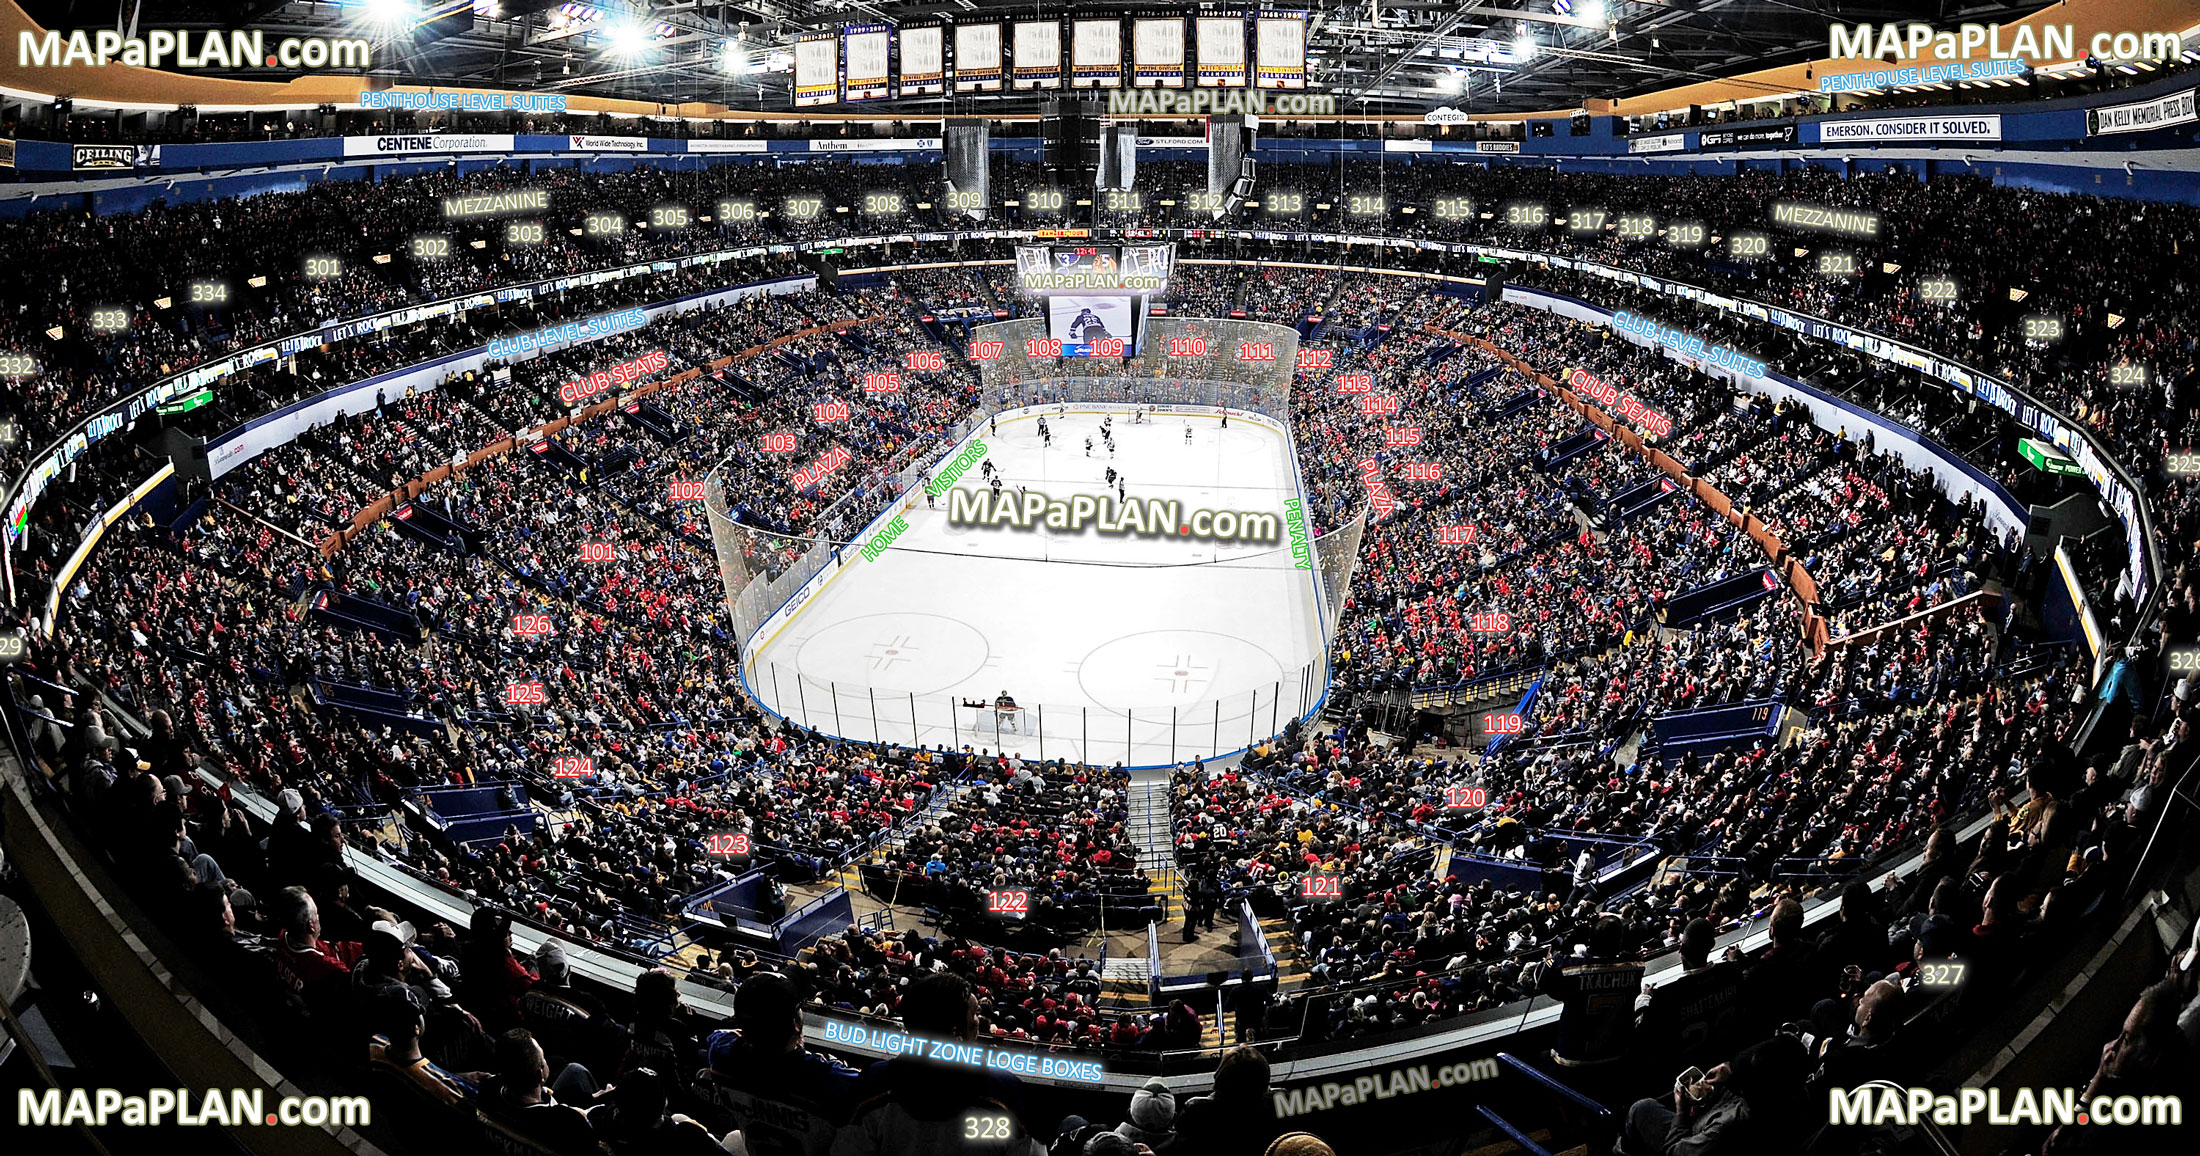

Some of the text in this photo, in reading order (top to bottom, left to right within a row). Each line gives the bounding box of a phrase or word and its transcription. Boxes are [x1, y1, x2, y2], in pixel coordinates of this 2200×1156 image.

[1426, 112, 1466, 122] CONTEGIX
[2100, 95, 2195, 129] DAN KELLY MEMORIAL PRESS BOX
[1826, 121, 1991, 137] EMERSON. CONSIDER IT SOLVED.
[377, 137, 432, 151] CENTENE
[585, 139, 599, 148] World
[636, 140, 645, 148] Inc.
[815, 140, 848, 150] Anthem
[76, 148, 132, 164] CEILING
[1075, 247, 1097, 256] 12:41
[1062, 254, 1070, 266] 3
[1101, 254, 1110, 267] 5
[784, 586, 811, 618] GEICO
[1751, 706, 1770, 721] 119
[1212, 826, 1227, 839] 20
[1578, 971, 1637, 992] TKACHUK
